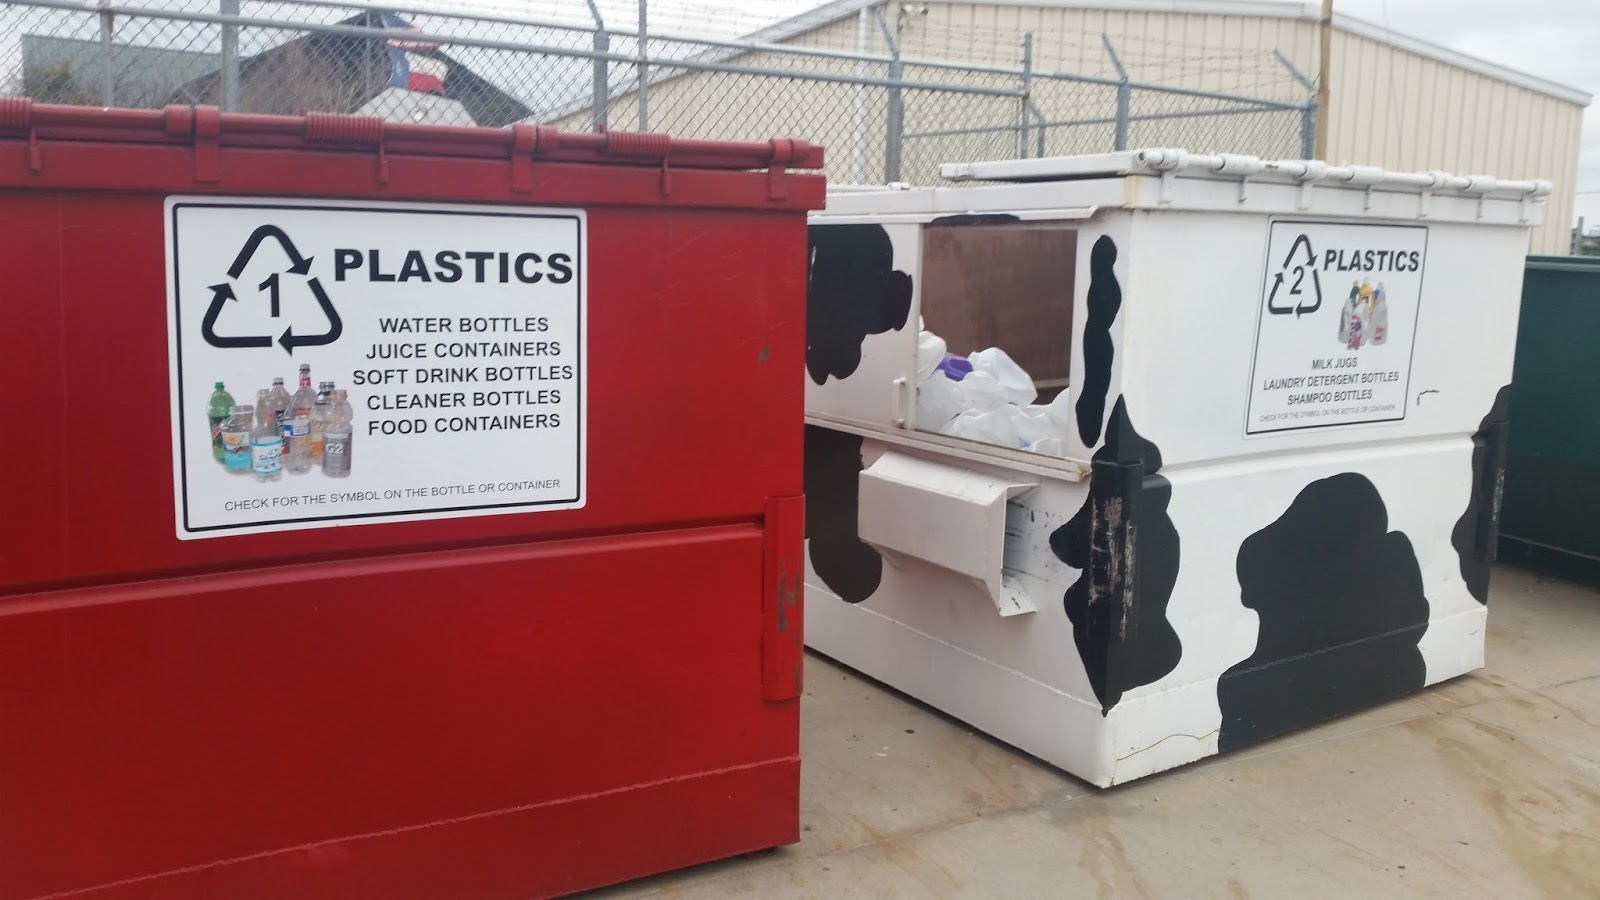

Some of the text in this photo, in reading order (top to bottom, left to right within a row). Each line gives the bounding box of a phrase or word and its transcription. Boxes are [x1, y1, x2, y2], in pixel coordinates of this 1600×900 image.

[334, 248, 573, 284] PLASTICS
[1323, 249, 1420, 272] PLASTICS
[1289, 265, 1305, 295] 2
[258, 273, 280, 318] 1
[379, 317, 549, 333] WATER BOTTLES
[366, 341, 562, 359] JUICE CONTAINERS
[1311, 357, 1358, 370] MILK JUGS
[352, 365, 573, 386] SOFT DRINK BOTTLES
[1263, 371, 1399, 390] LAUNDRY DETERGENT BOTTLES
[367, 389, 562, 410] CLEANER BOTTLES
[1287, 389, 1373, 405] SHAMPOO BOTTLES
[369, 413, 561, 436] FOOD CONTAINERS
[1259, 414, 1277, 422] CHECK
[325, 443, 344, 454] G2
[225, 479, 560, 511] CHECK FOR THE SYMBOL ON THE BOTTLE OR CONTAINER
